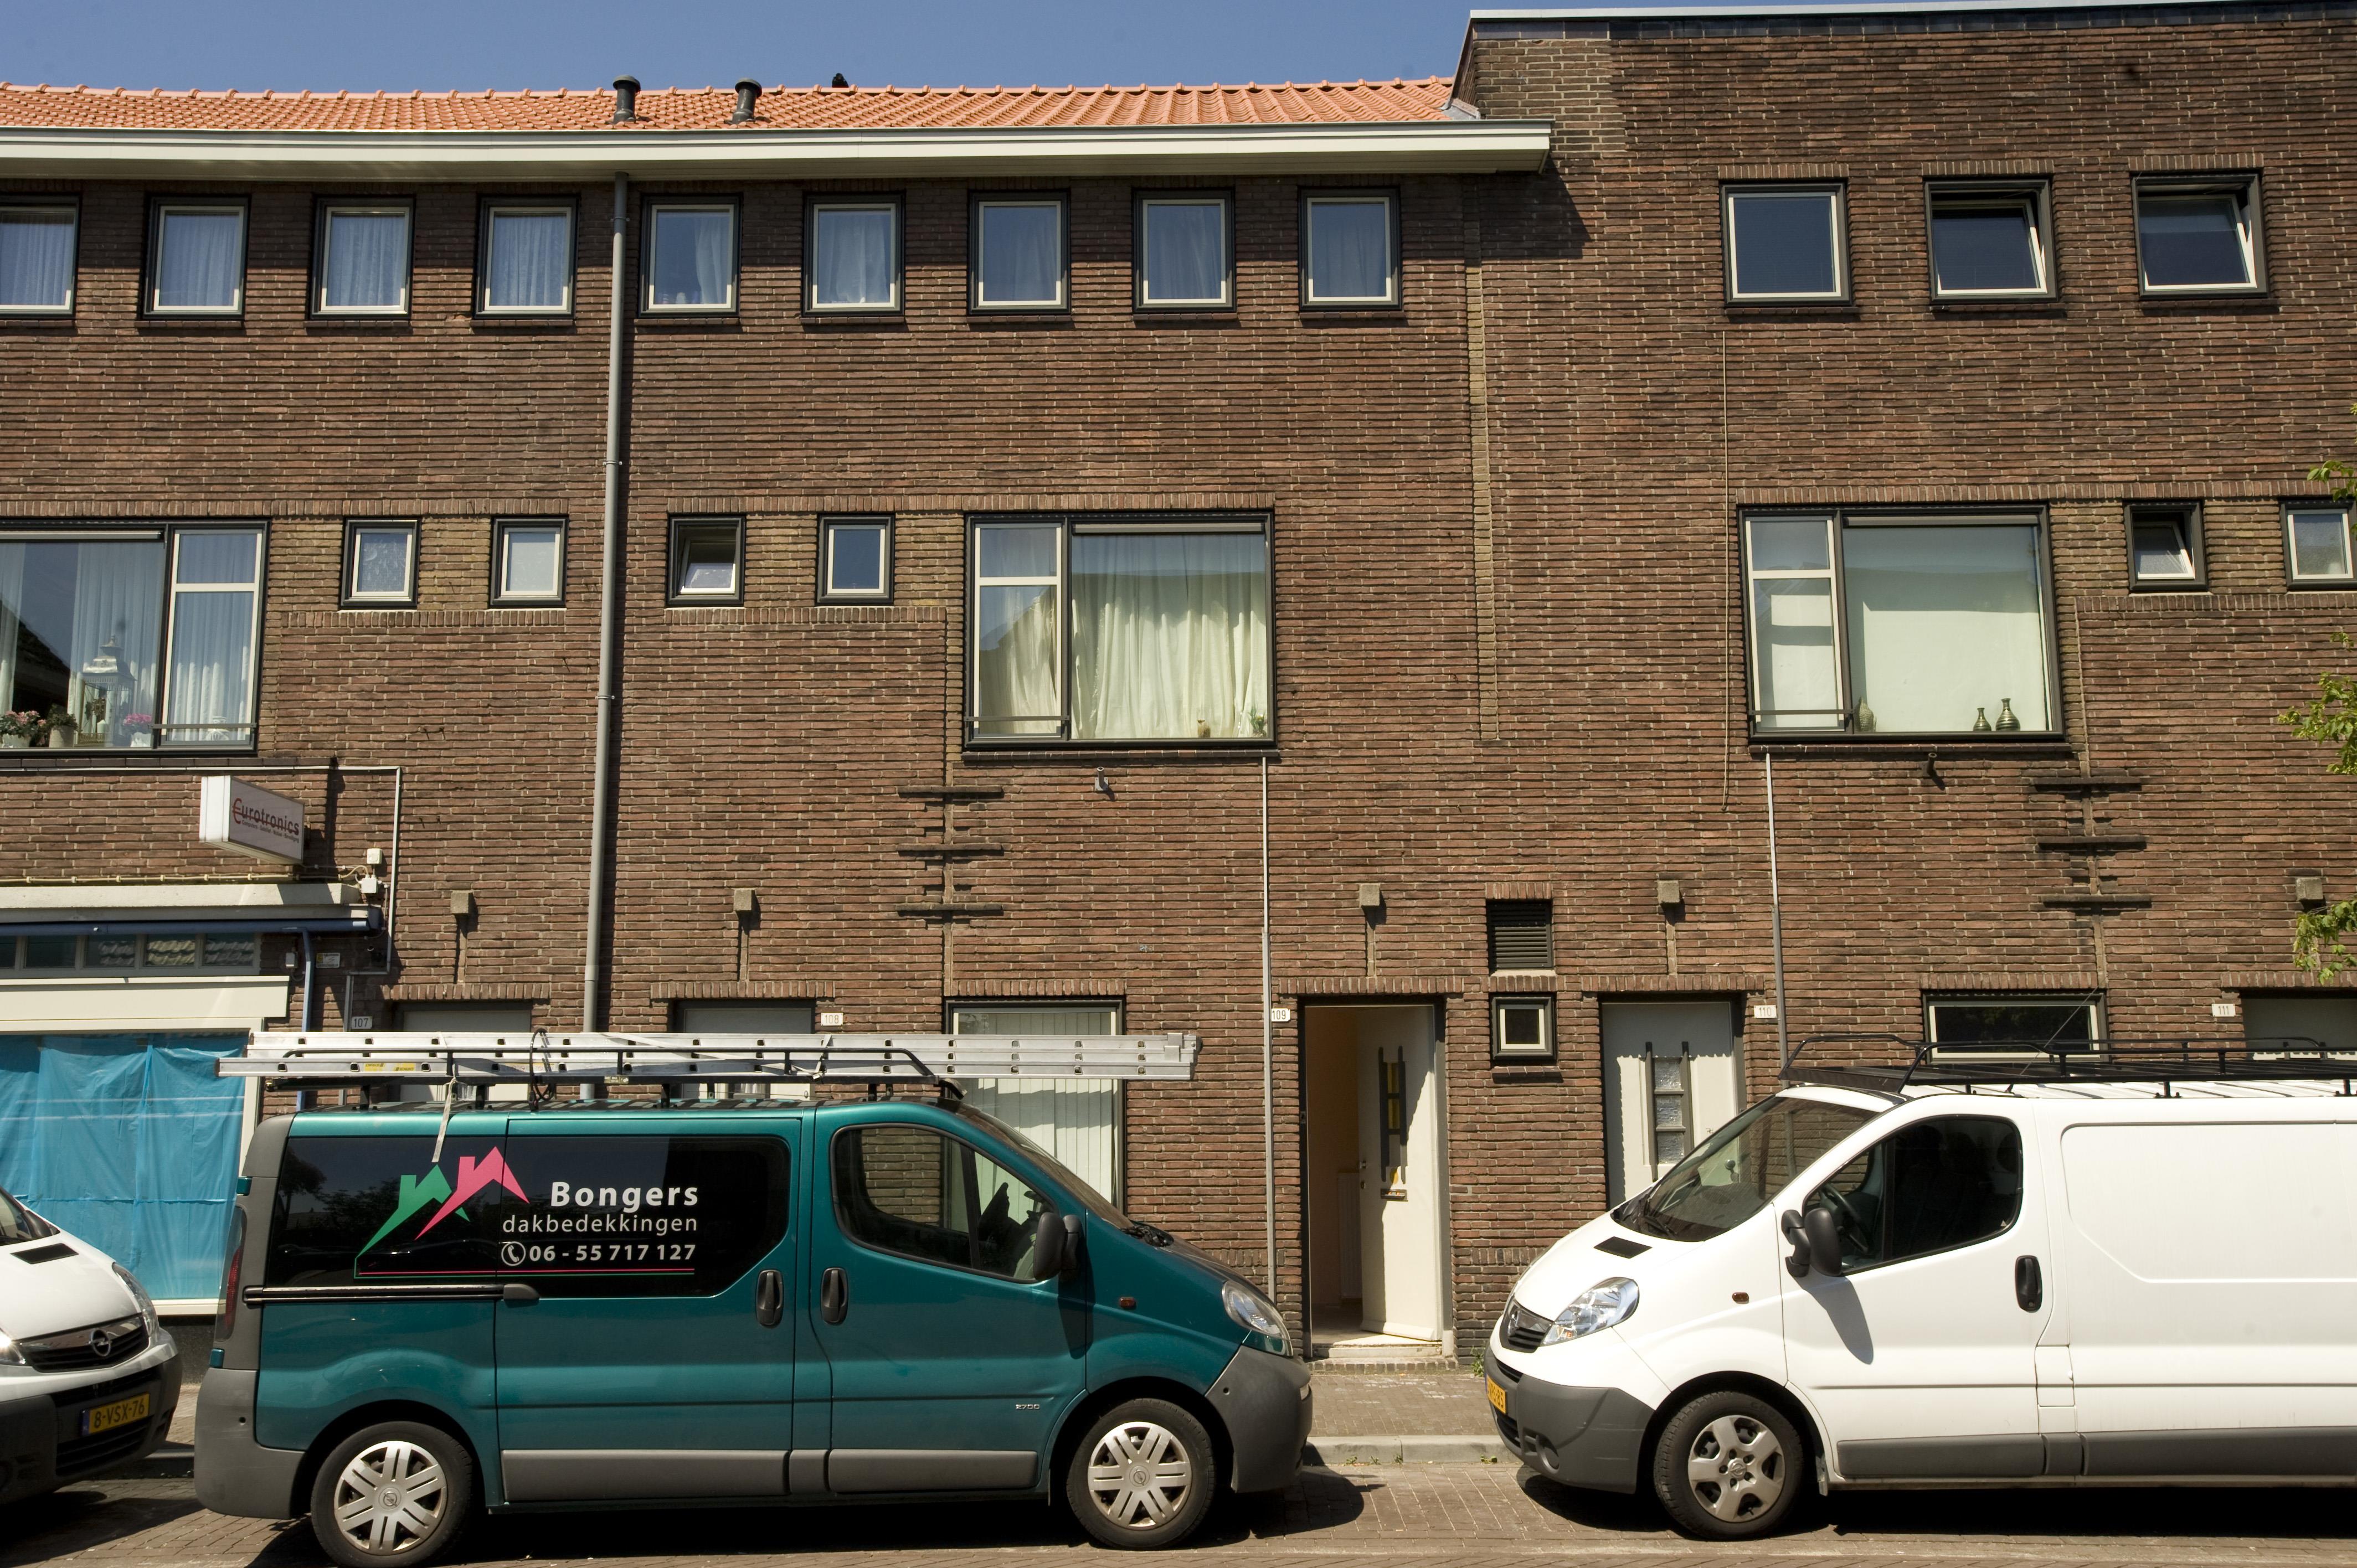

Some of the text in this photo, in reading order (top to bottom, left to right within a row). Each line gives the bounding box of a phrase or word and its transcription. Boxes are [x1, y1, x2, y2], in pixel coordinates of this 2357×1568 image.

[1272, 1010, 1286, 1020] 109
[1759, 1007, 1772, 1017] 110
[2218, 1005, 2229, 1015] 111
[354, 1018, 368, 1028] 107
[825, 1014, 839, 1024] 108
[550, 1182, 698, 1213] Bongers
[503, 1214, 697, 1236] dakbedekkingen
[529, 1245, 555, 1261] 06
[576, 1245, 602, 1261] 55
[609, 1245, 649, 1261] 717
[657, 1244, 696, 1260] 127
[93, 1398, 145, 1428] 8-VSX-76
